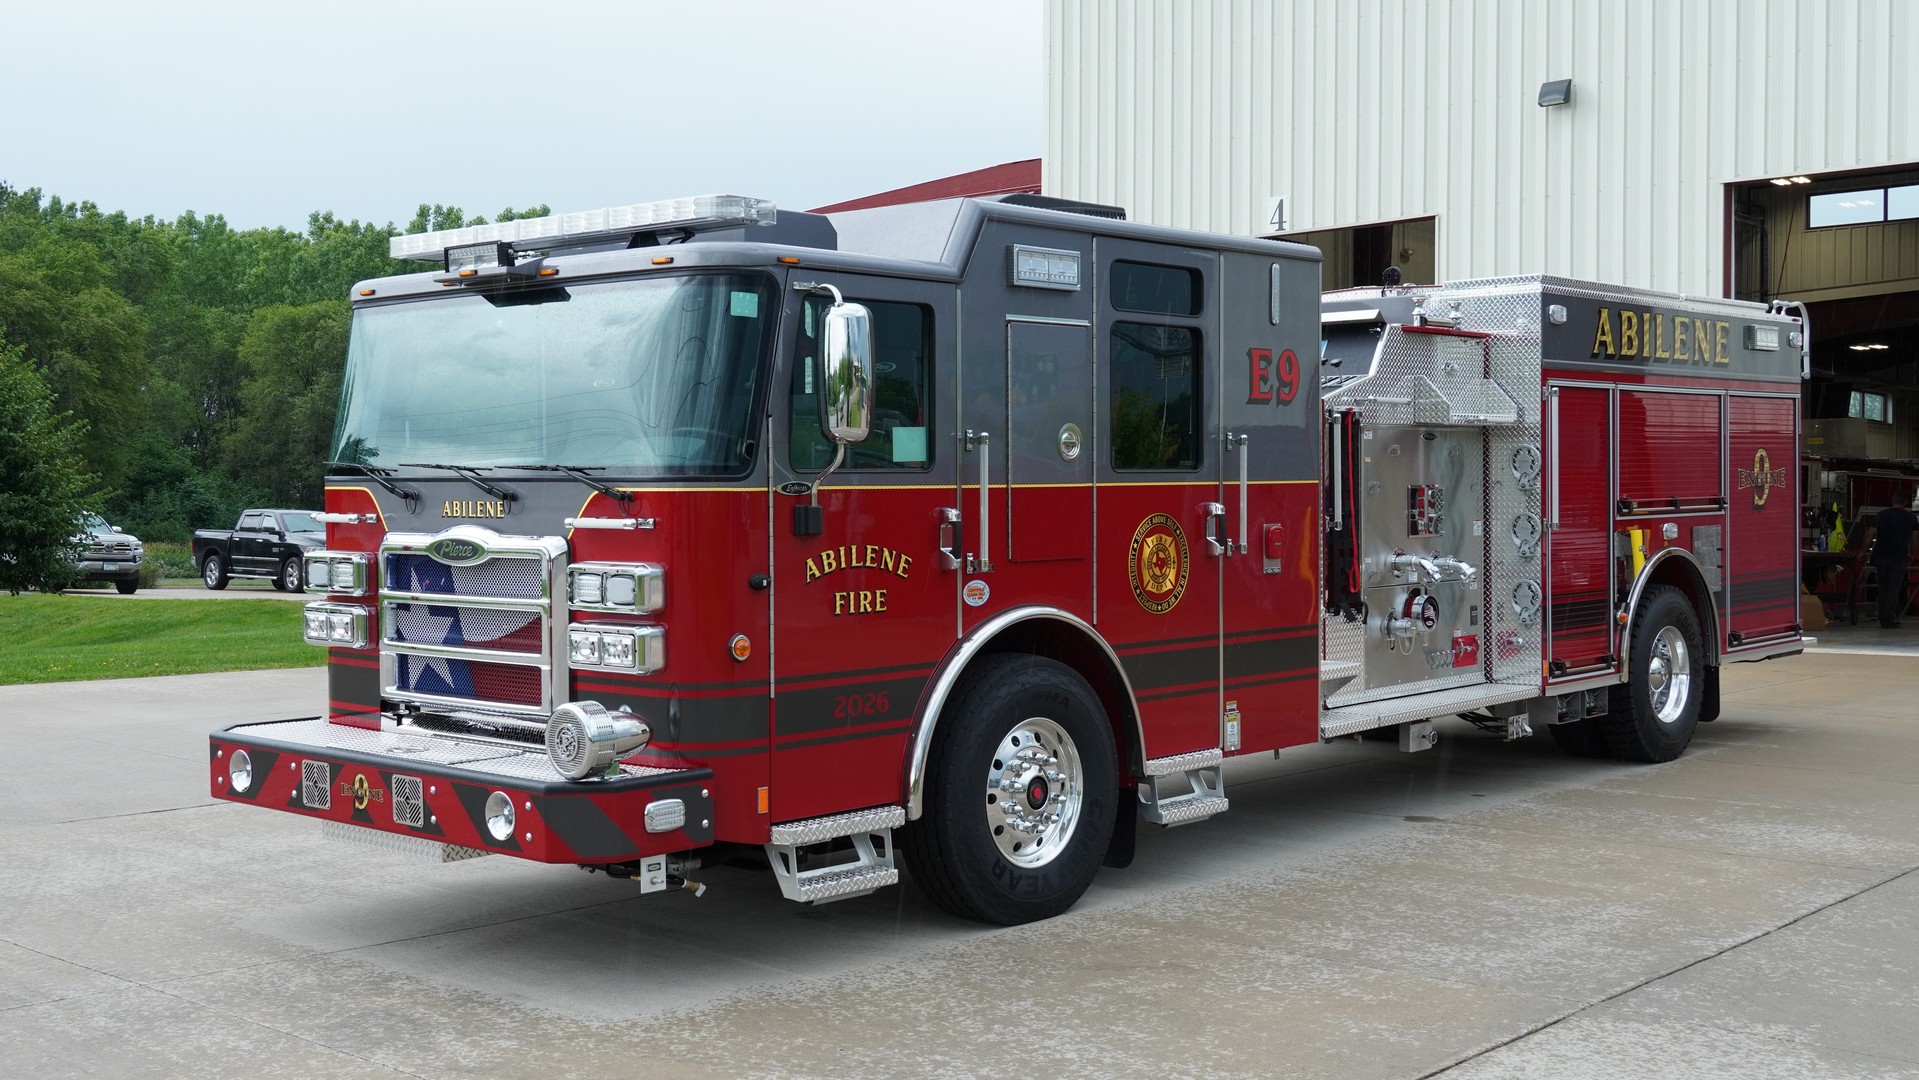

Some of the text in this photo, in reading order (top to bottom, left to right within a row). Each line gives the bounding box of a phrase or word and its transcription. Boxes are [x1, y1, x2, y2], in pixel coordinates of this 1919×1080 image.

[1270, 198, 1287, 232] 4
[1591, 307, 1730, 366] ABILENE
[1246, 347, 1300, 407] E9
[1738, 467, 1786, 490] ENGINE
[1754, 448, 1770, 506] 9
[442, 500, 505, 518] ABILENE
[1135, 516, 1178, 541] SERVICE ABOVE SELF
[1151, 535, 1168, 545] FIRE
[440, 540, 474, 559] Pierce
[805, 544, 913, 585] ABILENE
[1151, 582, 1168, 591] DEPT
[833, 589, 888, 615] FIRE
[833, 691, 890, 719] 2026
[341, 782, 384, 803] ENGINE
[354, 773, 369, 809] 9
